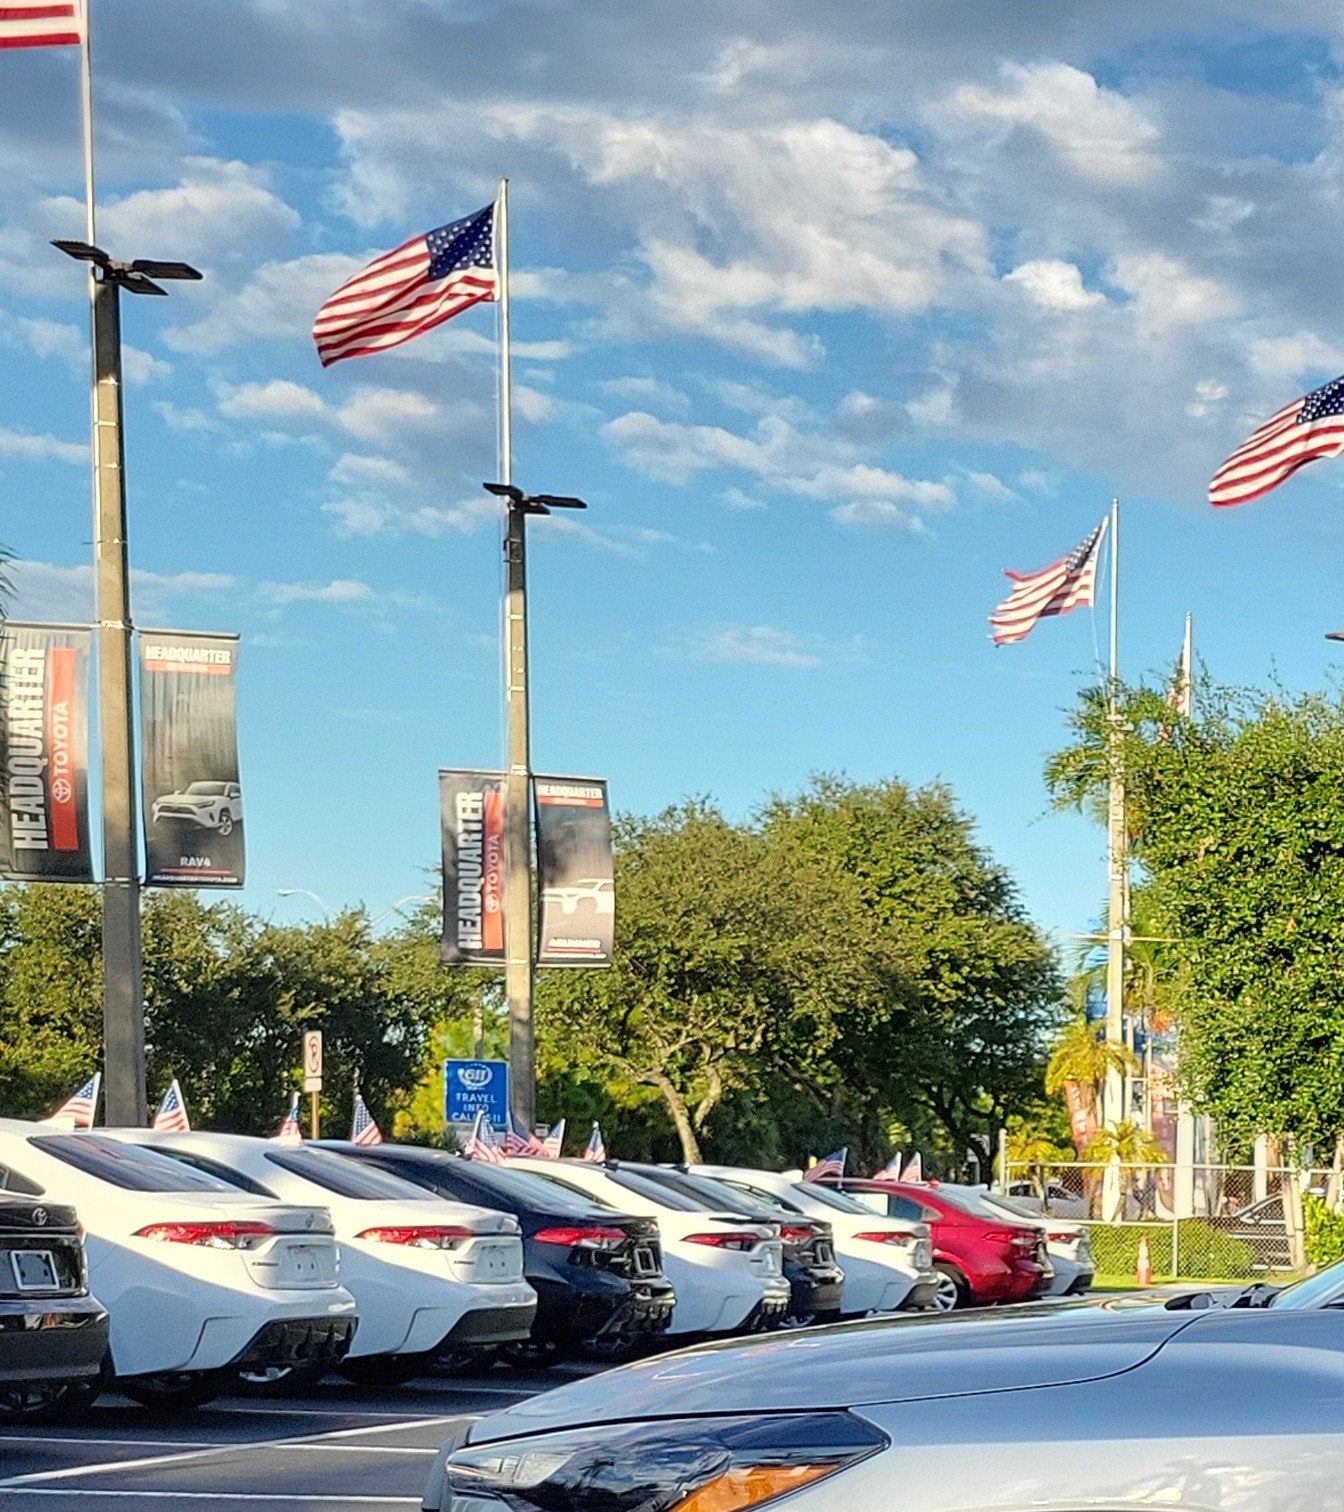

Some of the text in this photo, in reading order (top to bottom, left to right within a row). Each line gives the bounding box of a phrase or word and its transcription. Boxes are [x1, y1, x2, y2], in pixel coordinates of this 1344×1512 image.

[146, 645, 231, 664] HEADQUARTER
[8, 648, 49, 850] HEADQUARTER
[53, 701, 70, 777] TOYOTA
[457, 792, 485, 949] HEADQUARTER
[486, 834, 500, 889] TOYOTA
[456, 1092, 496, 1104] TRAVEL
[463, 1103, 489, 1112] INFO
